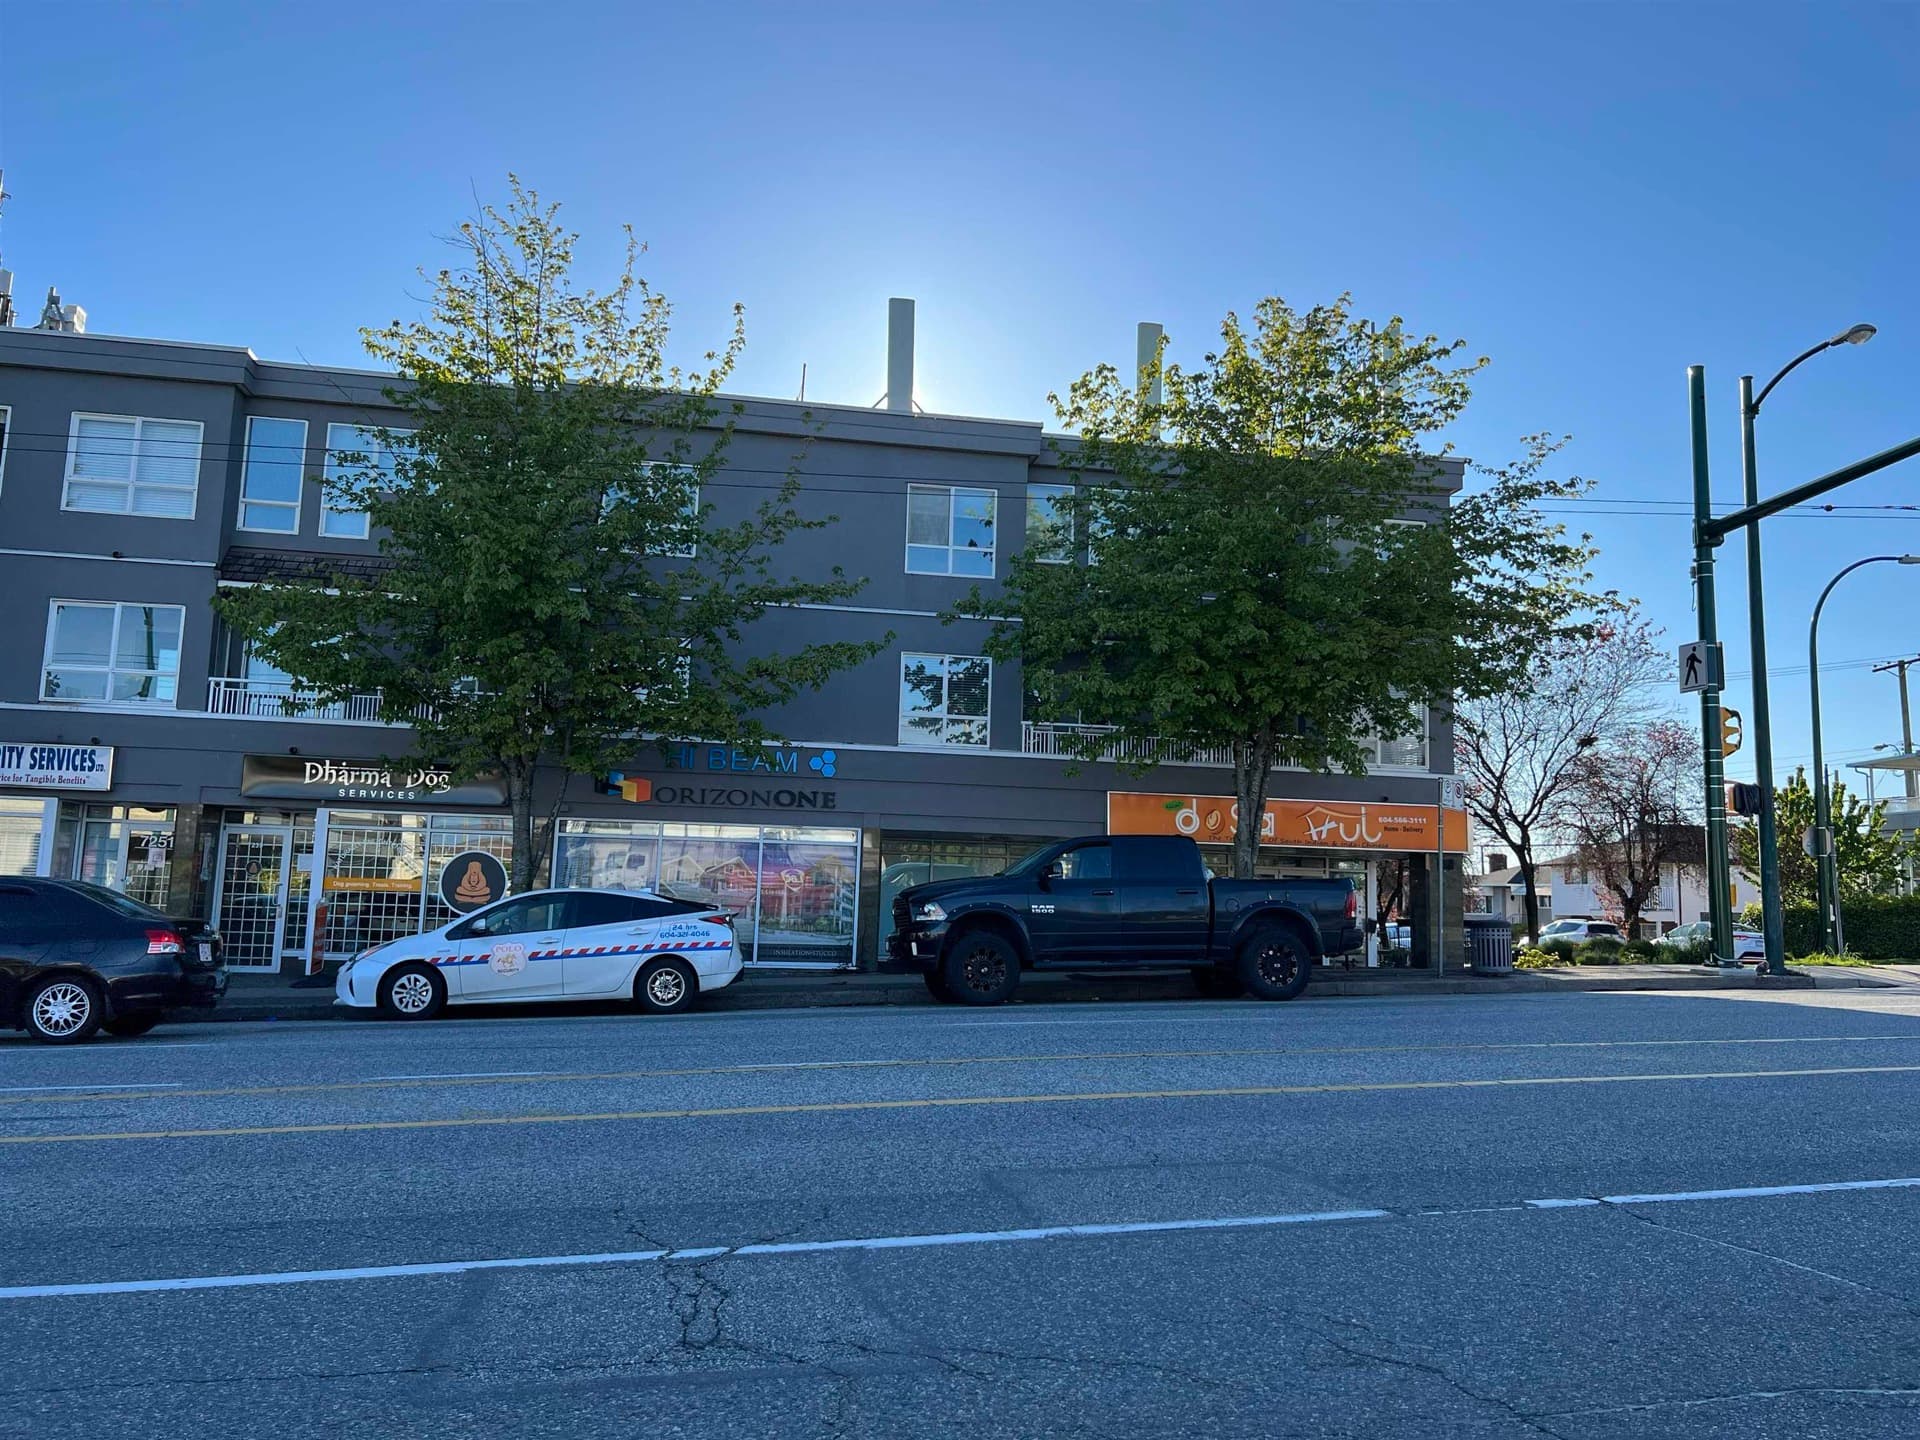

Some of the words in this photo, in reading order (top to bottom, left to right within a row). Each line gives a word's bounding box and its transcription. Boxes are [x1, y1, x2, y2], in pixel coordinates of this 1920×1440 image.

[0, 746, 24, 769] ITY
[29, 747, 96, 773] SERVICES
[708, 746, 798, 773] BEAM
[25, 774, 56, 784] Tangible
[304, 760, 392, 788] Dharma
[405, 765, 452, 794] Dog
[338, 789, 415, 800] SERVICES
[140, 835, 174, 848] 7251
